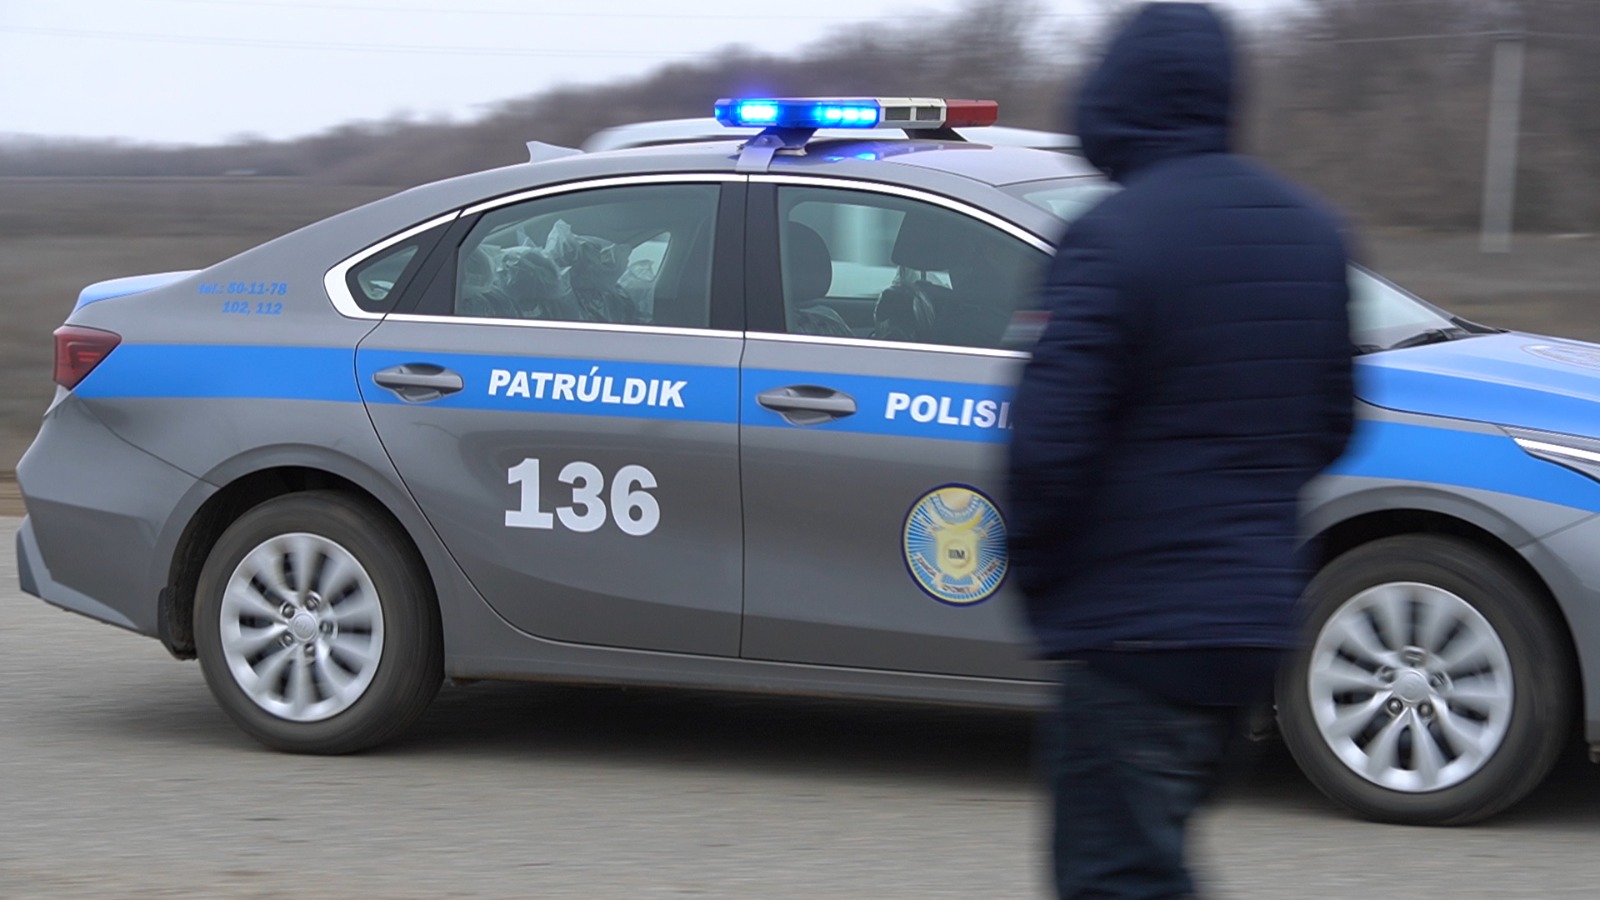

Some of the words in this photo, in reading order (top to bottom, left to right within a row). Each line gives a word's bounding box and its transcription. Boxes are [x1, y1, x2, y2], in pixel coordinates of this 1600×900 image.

[222, 300, 251, 315] 102,
[255, 301, 284, 315] 112
[227, 281, 288, 297] 50-11-78
[488, 366, 687, 408] PATRÚLDIK
[885, 392, 1015, 430] POLISI
[504, 457, 661, 537] 136
